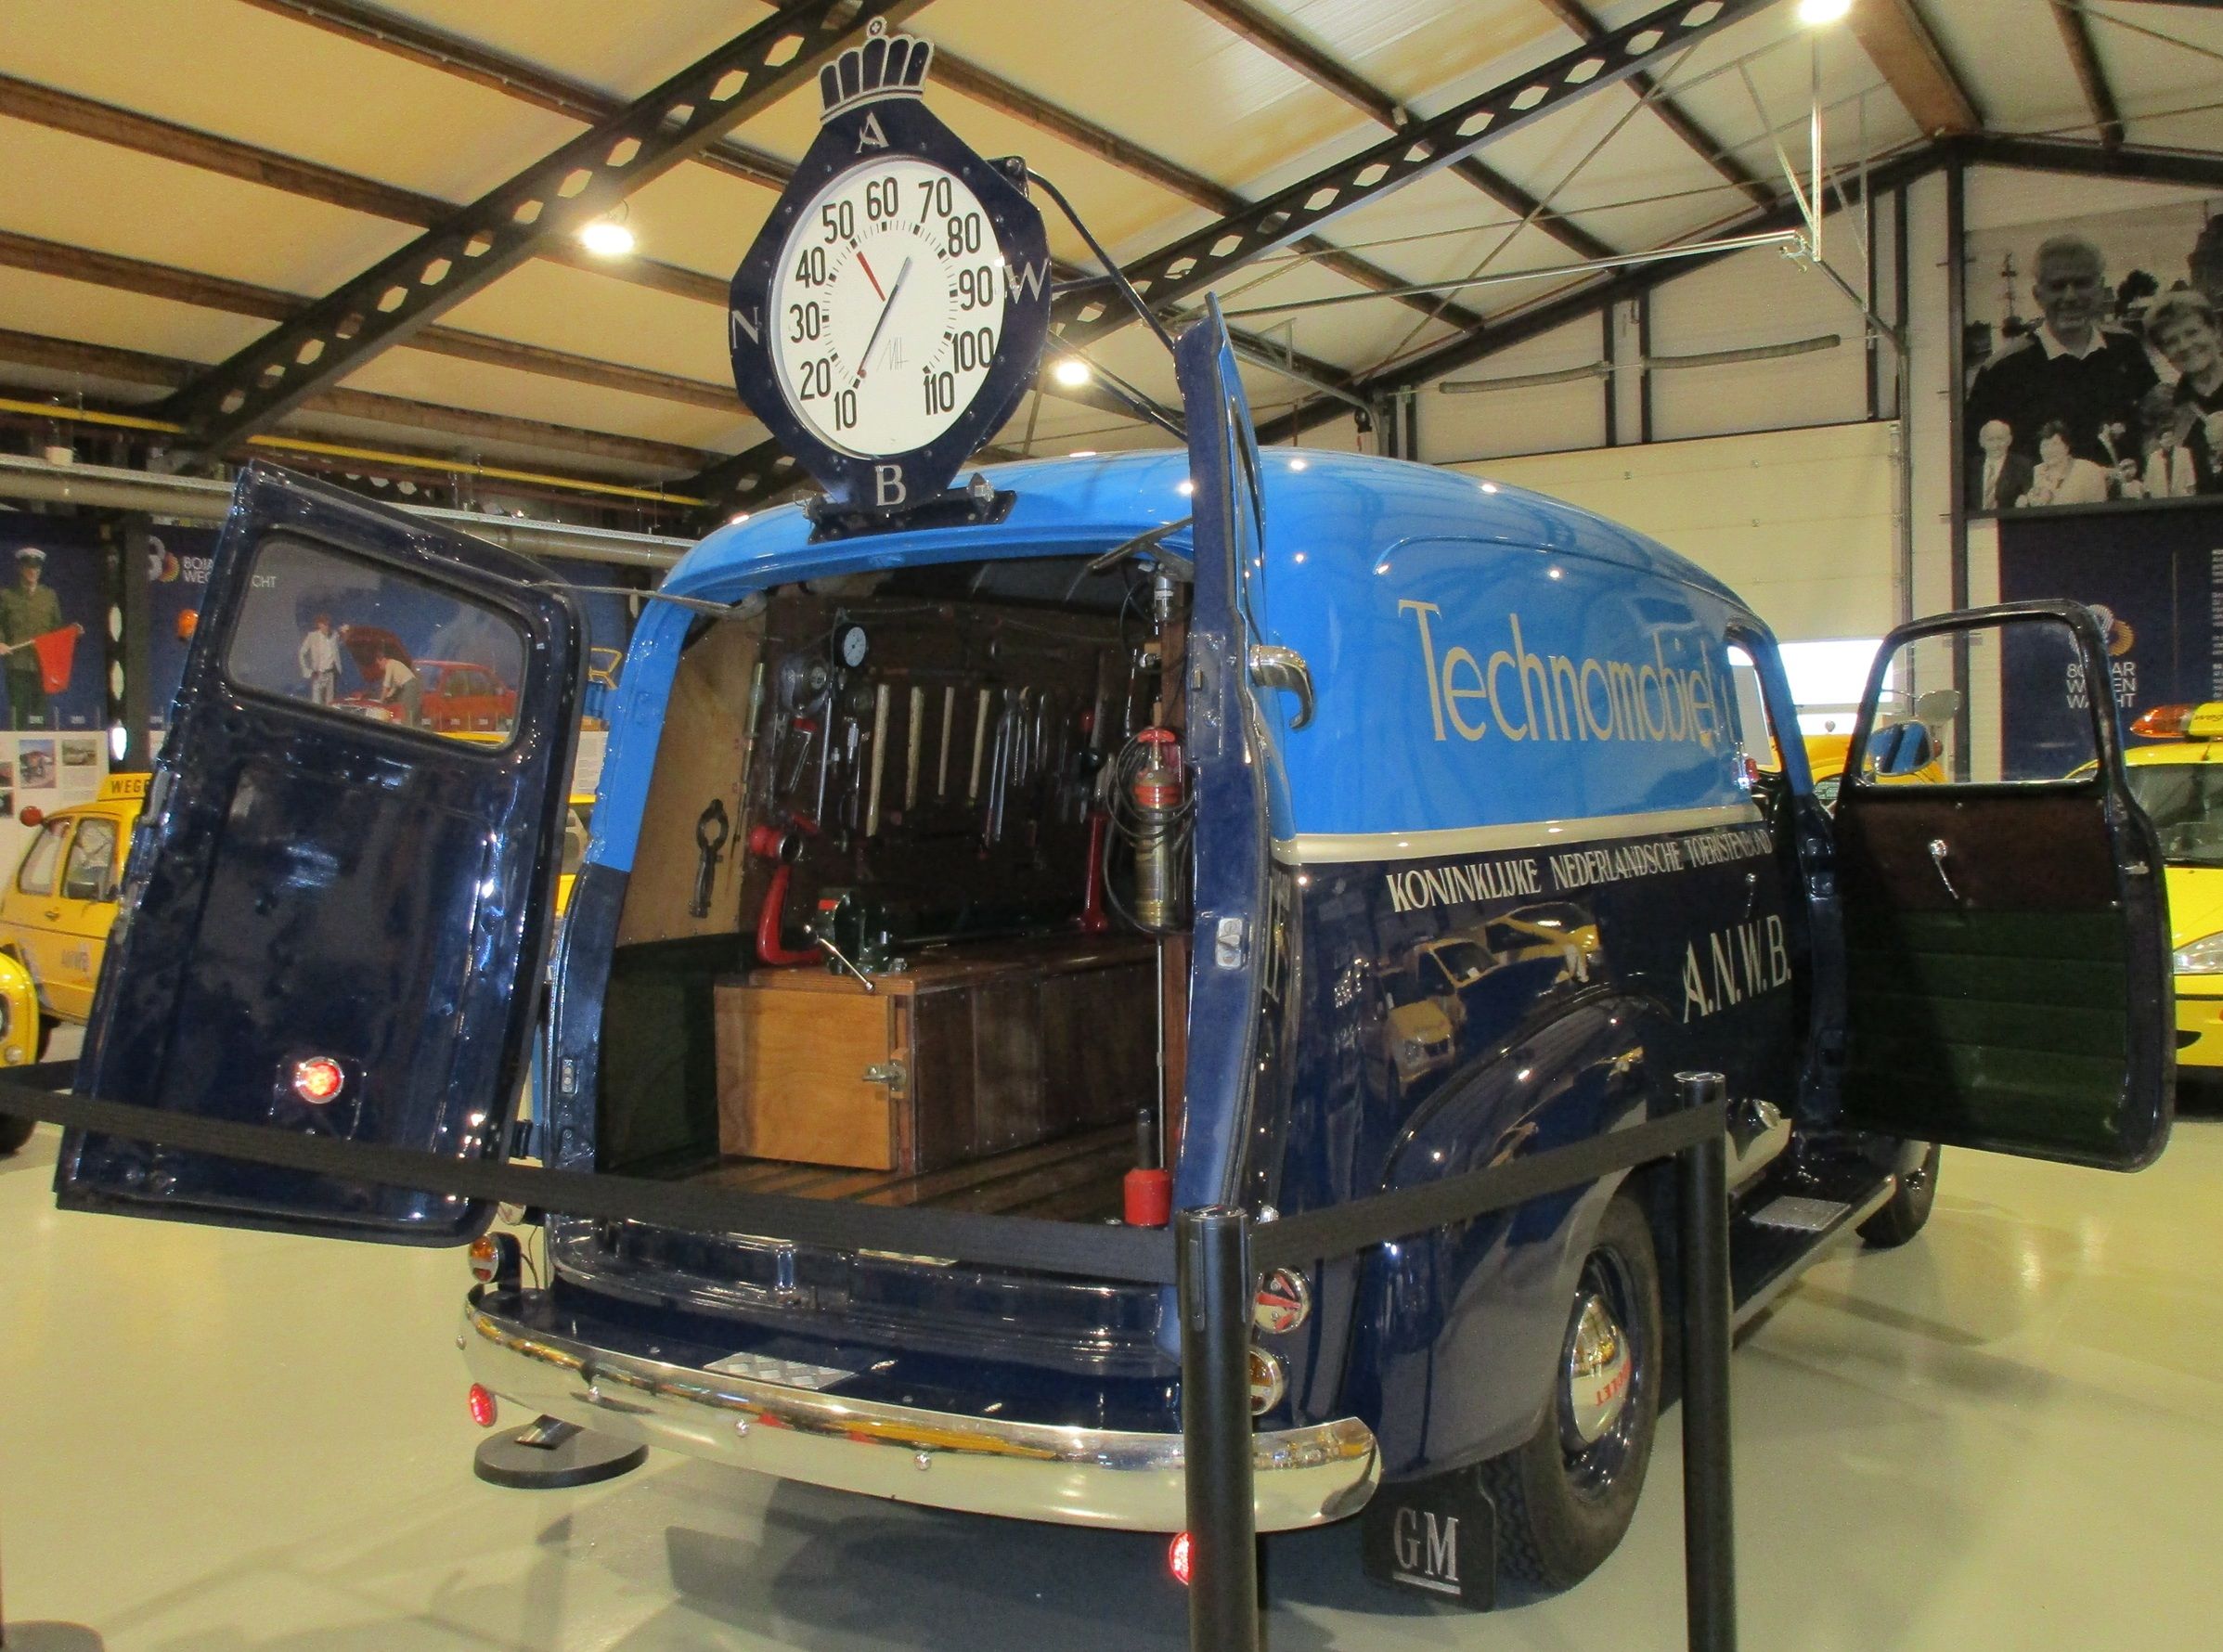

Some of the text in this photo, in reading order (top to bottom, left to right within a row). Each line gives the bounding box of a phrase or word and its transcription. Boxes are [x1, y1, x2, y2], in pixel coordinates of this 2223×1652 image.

[855, 111, 889, 155] A
[866, 176, 898, 221] 60
[918, 176, 952, 224] 70
[821, 200, 855, 244] 50
[947, 212, 980, 258] 80
[795, 246, 826, 288] 40
[959, 265, 993, 311] 90
[1002, 258, 1048, 304] W
[731, 307, 761, 349] N
[789, 302, 821, 343] 30
[950, 327, 994, 373] 100
[800, 357, 832, 402] 20
[923, 371, 955, 416] 110
[834, 389, 857, 431] 10
[874, 464, 907, 507] B
[1399, 600, 1721, 742] Technomobiel
[1386, 858, 1542, 912] KONINKLIJKE
[1549, 841, 1685, 891] NEDERLANDSCHE
[1394, 1506, 1459, 1581] GM
